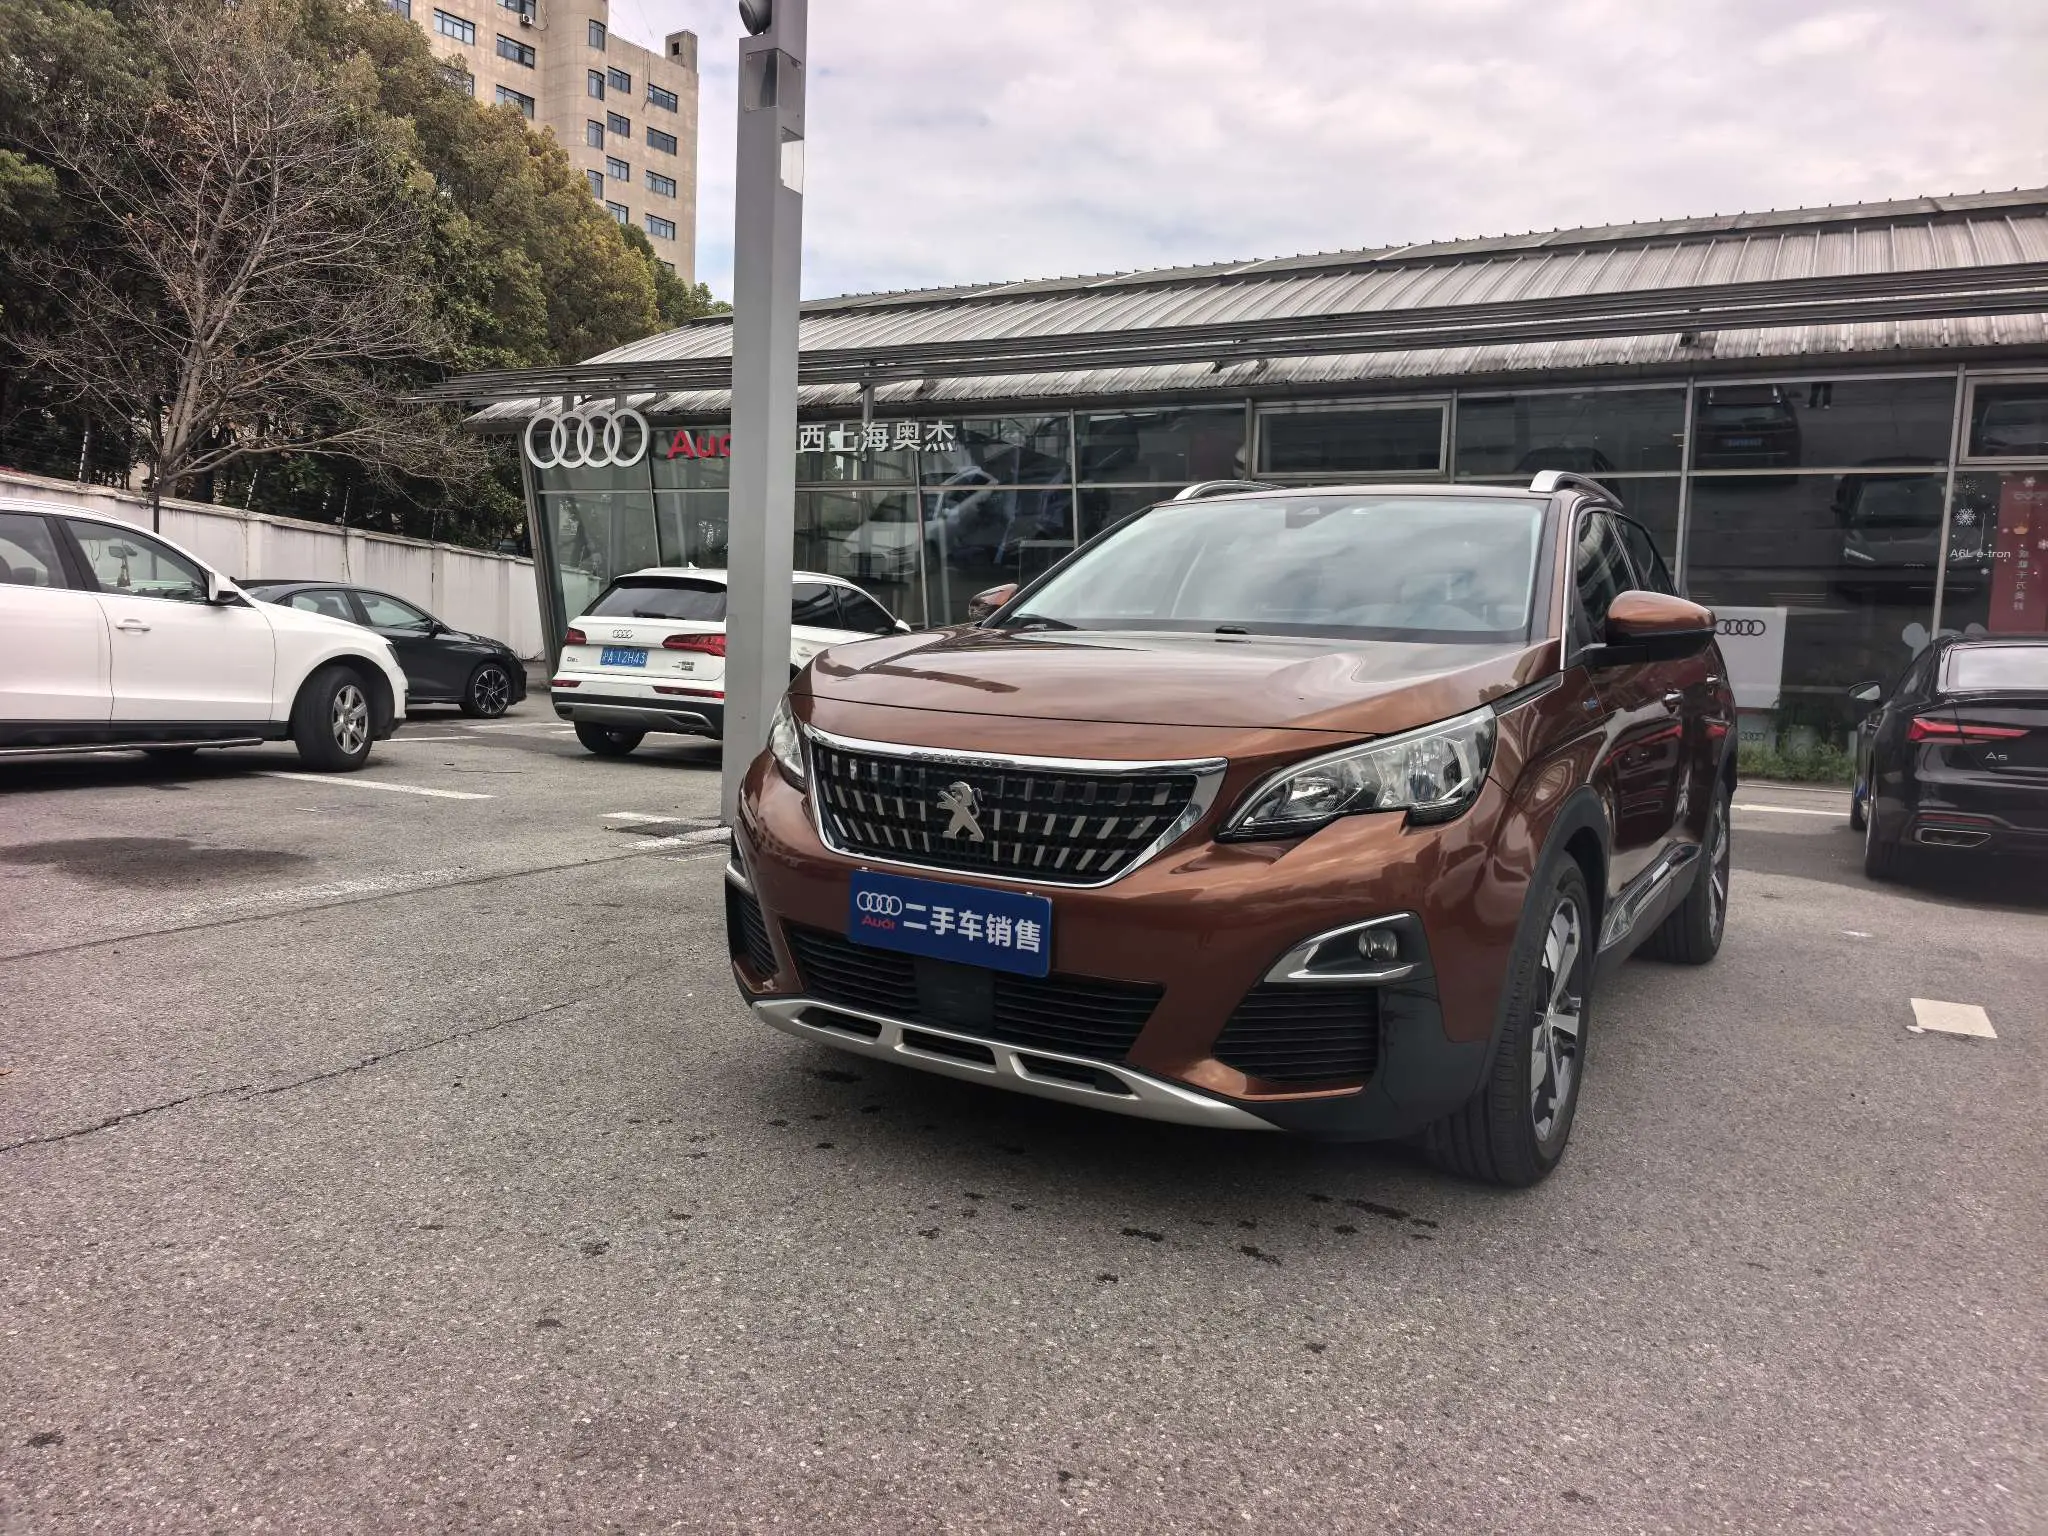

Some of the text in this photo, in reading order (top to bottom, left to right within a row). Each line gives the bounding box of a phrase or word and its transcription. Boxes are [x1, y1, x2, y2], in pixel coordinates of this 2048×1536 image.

[799, 420, 956, 453] 西上海奥杰
[1949, 548, 2011, 559] A6L e-tron
[861, 915, 896, 930] Audi
[903, 903, 1041, 953] 二手车销售
